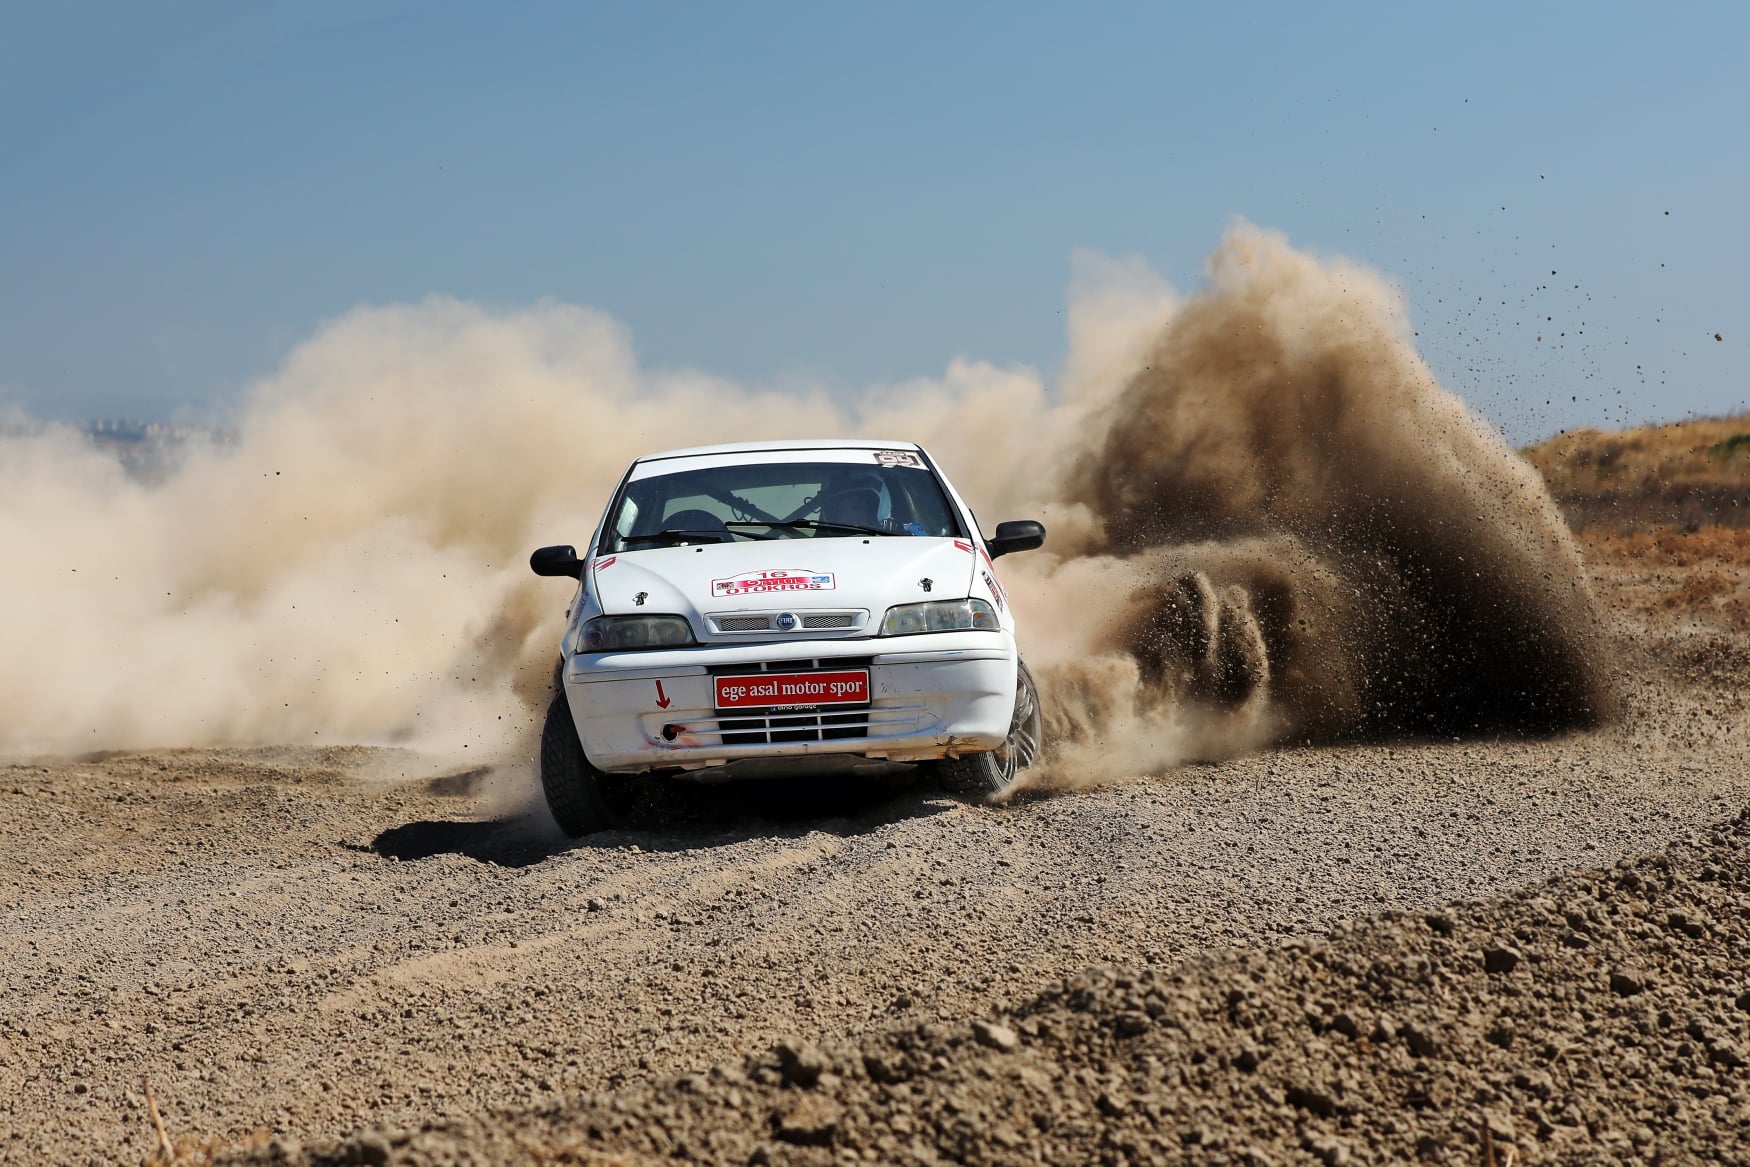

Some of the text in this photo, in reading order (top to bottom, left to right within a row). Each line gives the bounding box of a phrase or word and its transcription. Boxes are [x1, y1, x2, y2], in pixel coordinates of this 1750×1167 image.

[757, 571, 788, 579] 16
[726, 583, 822, 595] OTOKROS
[721, 681, 863, 701] ege asal motor spor
